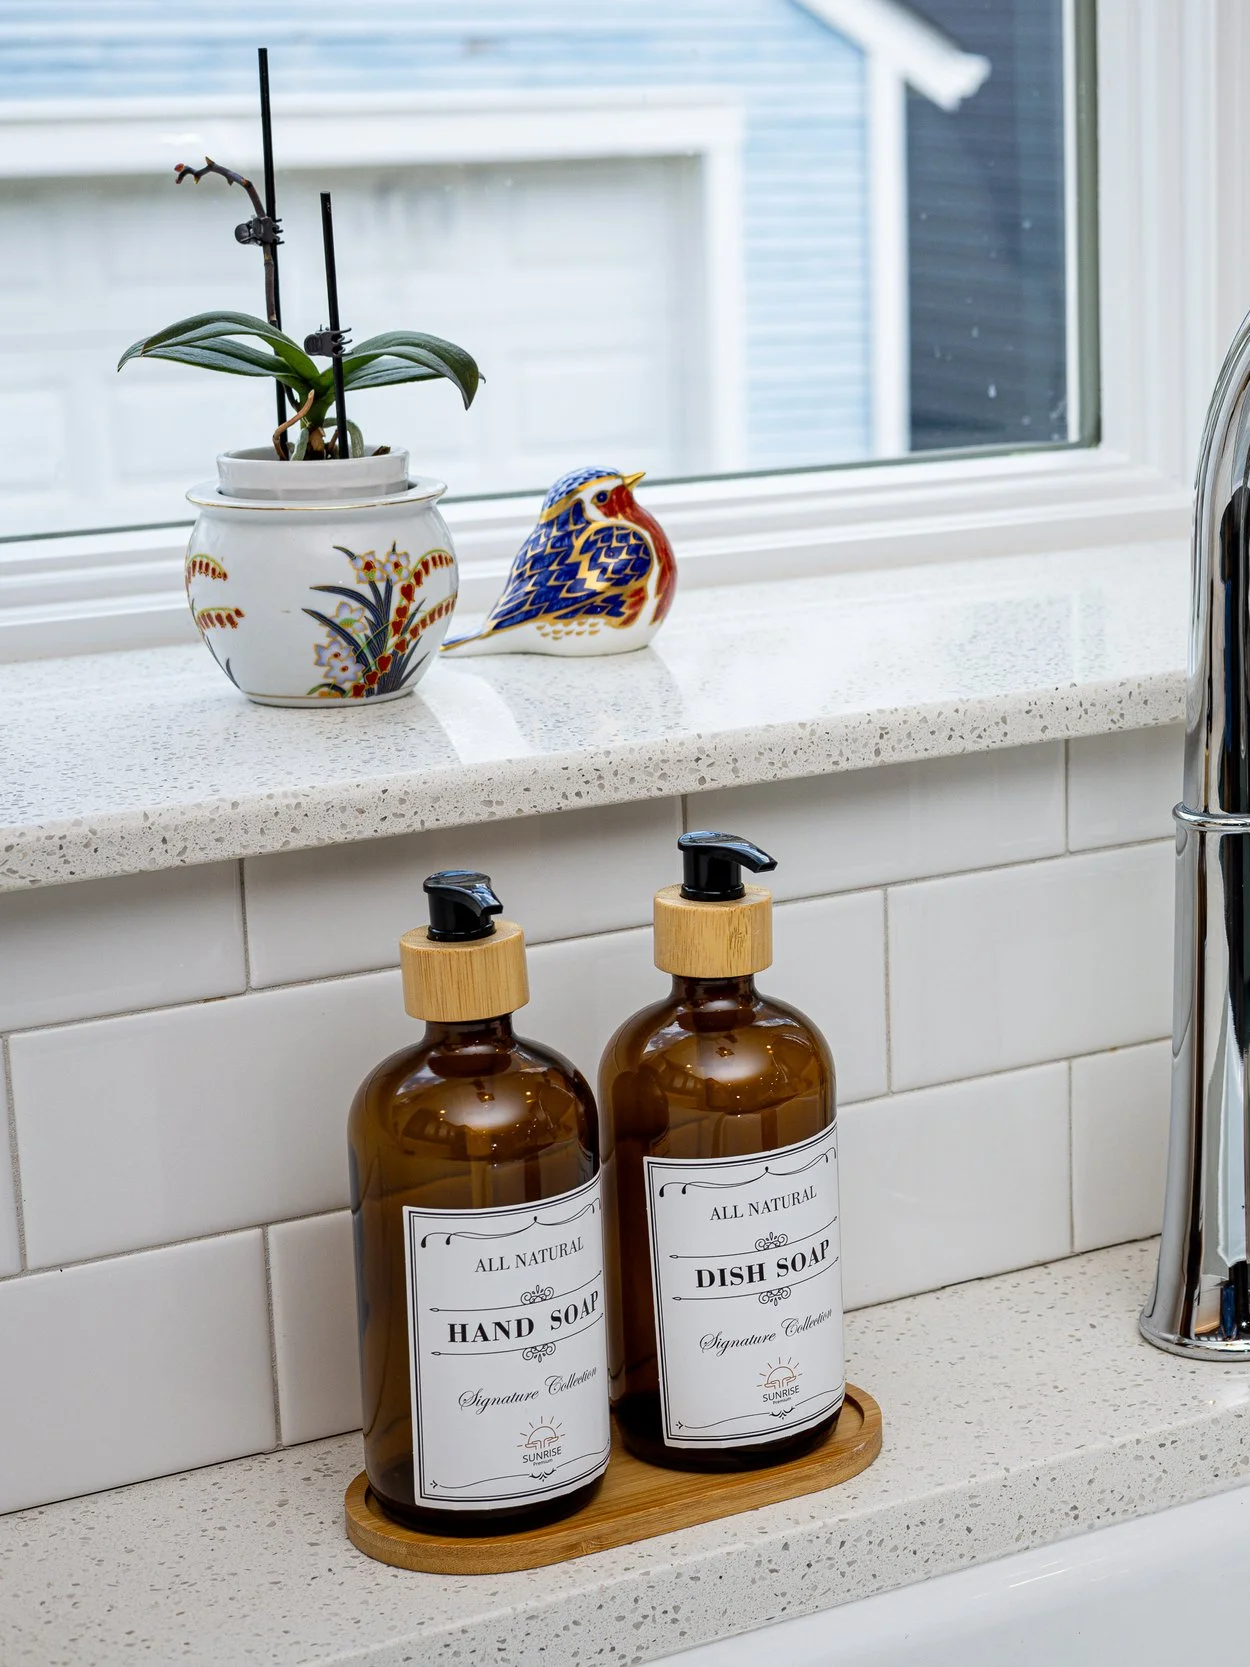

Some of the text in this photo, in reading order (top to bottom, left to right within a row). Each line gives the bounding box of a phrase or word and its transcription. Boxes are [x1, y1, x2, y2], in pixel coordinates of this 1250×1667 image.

[709, 1185, 817, 1221] ALL NATURAL
[475, 1236, 584, 1273] ALL NATURAL
[695, 1239, 829, 1288] DISH SOAP
[447, 1290, 599, 1343] HAND SOAP
[699, 1308, 833, 1357] Signature Collection
[458, 1366, 598, 1415] Signature Collection
[762, 1385, 800, 1403] SUNRISE
[522, 1446, 562, 1464] SUNRISE
